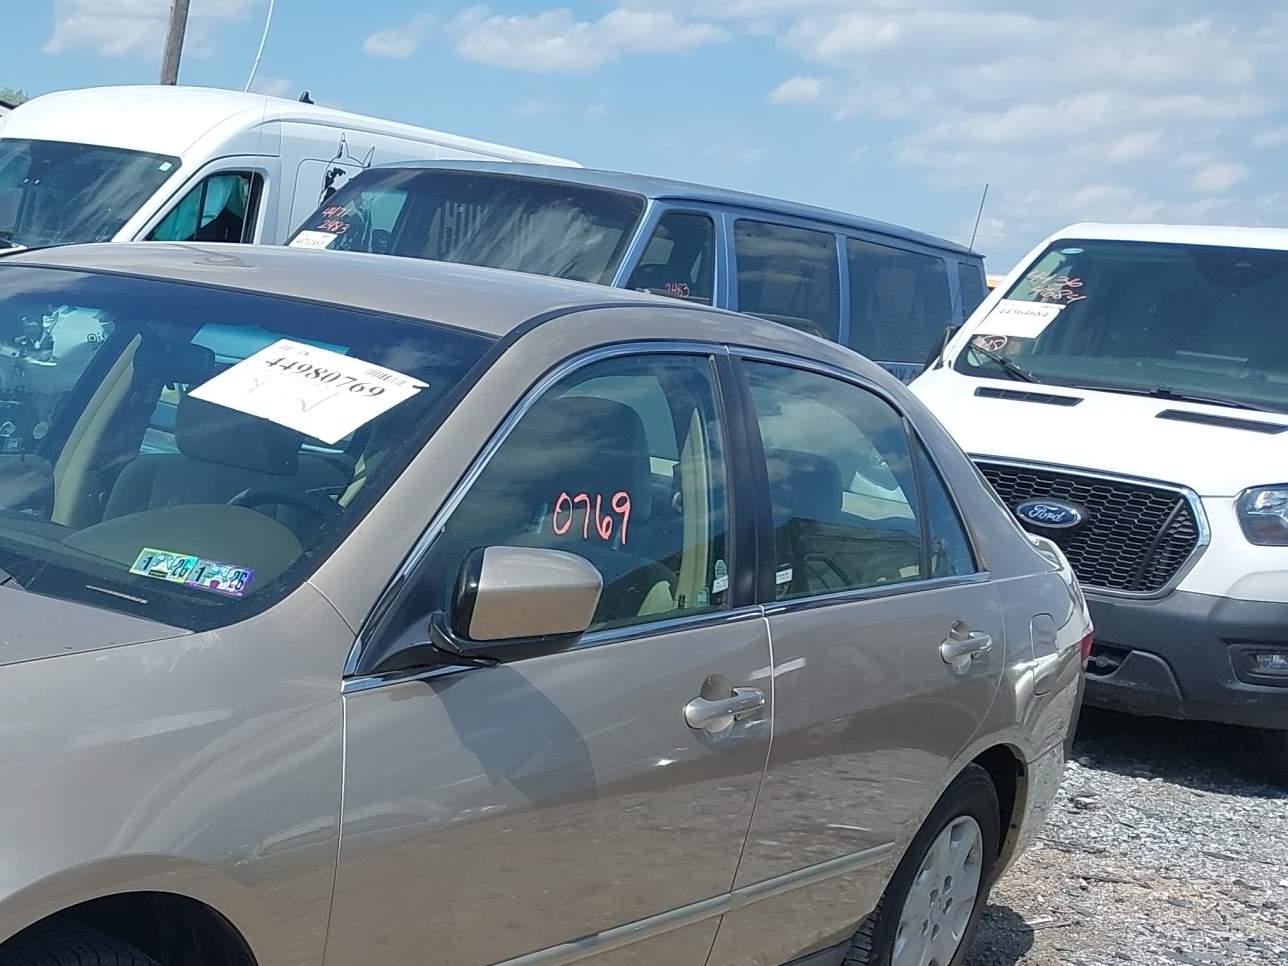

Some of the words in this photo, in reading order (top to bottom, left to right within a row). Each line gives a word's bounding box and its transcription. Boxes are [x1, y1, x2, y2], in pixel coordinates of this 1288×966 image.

[265, 357, 385, 397] 44980769
[553, 492, 631, 545] 0769
[1028, 504, 1066, 522] Ford
